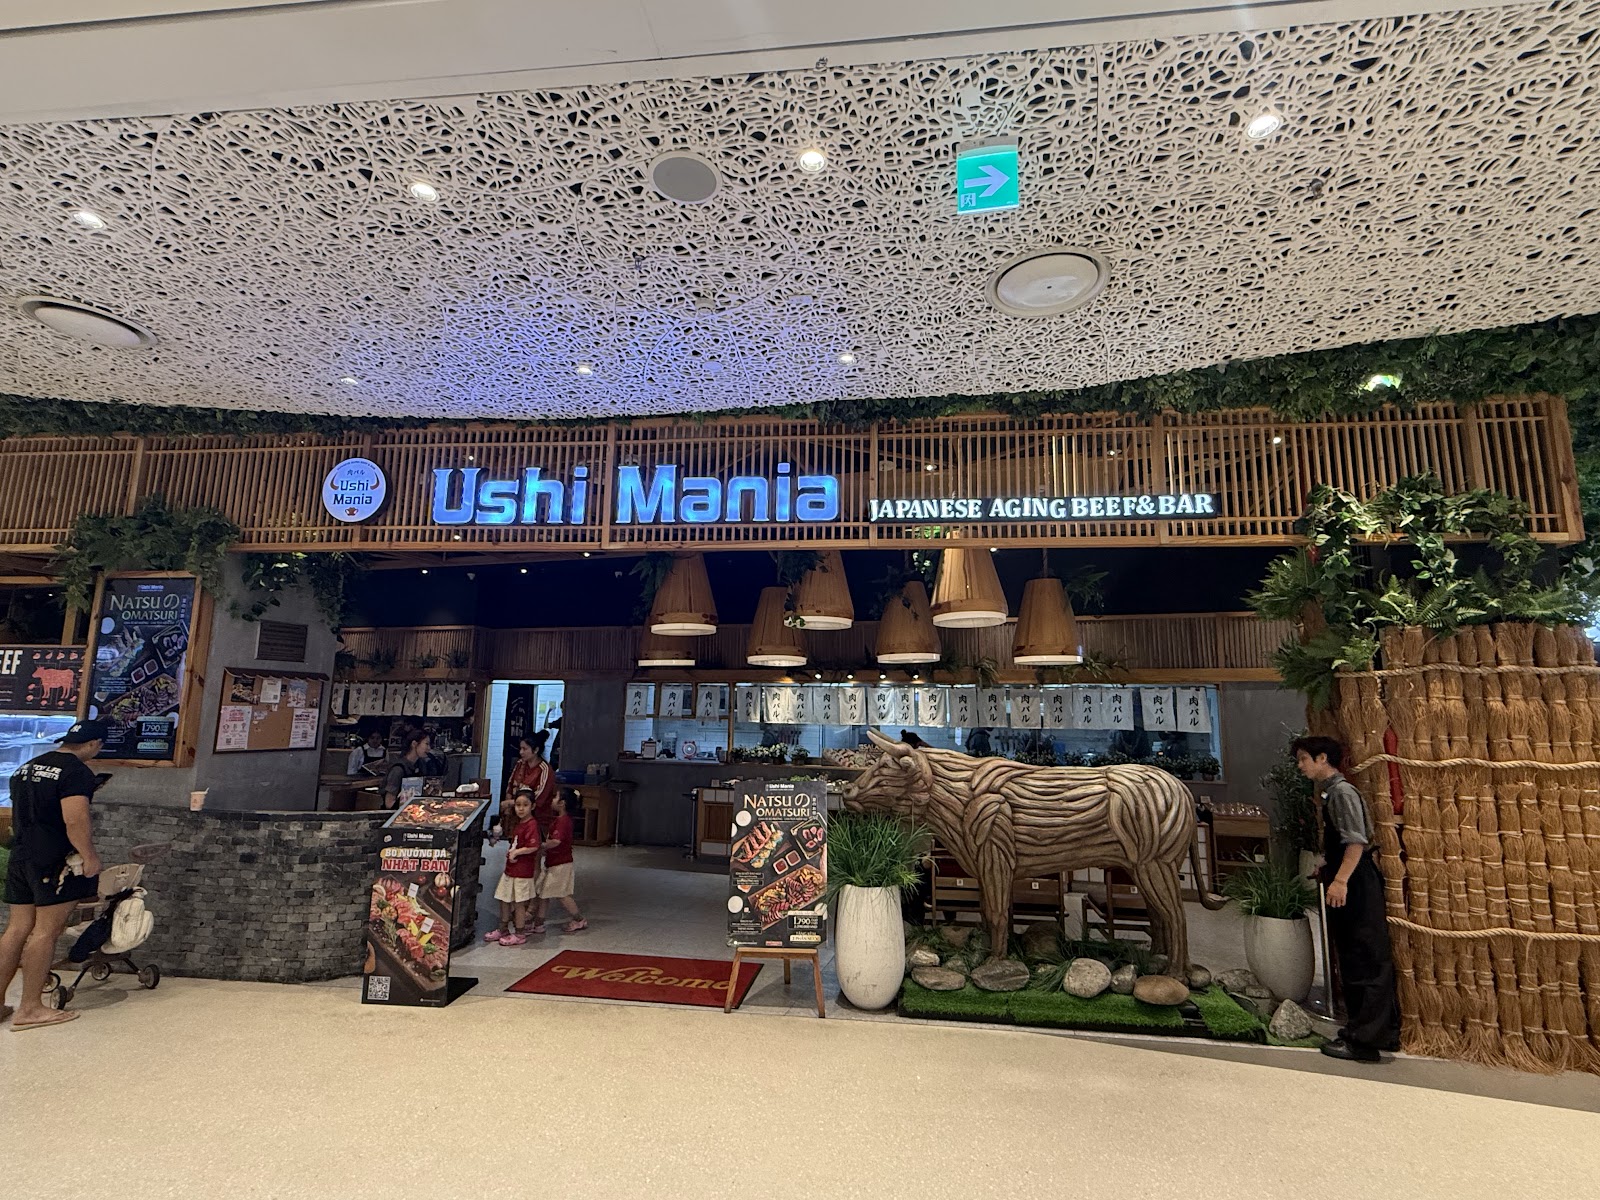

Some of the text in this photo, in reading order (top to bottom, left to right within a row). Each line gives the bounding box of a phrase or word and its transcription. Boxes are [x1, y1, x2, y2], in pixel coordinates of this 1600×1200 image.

[340, 480, 369, 491] Ushi
[432, 462, 839, 525] Ushi Mania
[333, 493, 372, 505] Mania
[869, 498, 982, 521] JAPANESE
[990, 497, 1066, 519] AGING
[109, 594, 160, 611] NATSU
[163, 594, 180, 610] の
[122, 610, 178, 621] OMATSURI
[632, 690, 642, 715] 肉バル
[668, 691, 677, 716] 肉バル
[704, 691, 712, 716] 肉バル
[745, 691, 753, 717] 肉バル
[772, 692, 781, 718] 肉バル
[796, 692, 804, 719] 肉バル
[823, 693, 831, 719] 肉バル
[848, 693, 857, 719] 肉バル
[877, 693, 886, 720] 肉バル
[901, 693, 909, 720] 肉バル
[928, 693, 937, 721] 肉バル
[958, 694, 968, 722] 肉バル
[988, 693, 997, 722] 肉バル
[1020, 694, 1030, 723] 肉バル
[1053, 694, 1063, 723] 肉バル
[1083, 694, 1092, 723] 肉バル
[1112, 693, 1122, 723] 肉バル
[1153, 695, 1164, 725] 肉バル
[1189, 696, 1199, 726] 肉バル
[743, 794, 792, 809] NATSU
[794, 793, 811, 808] の
[756, 807, 810, 817] OMATSURI
